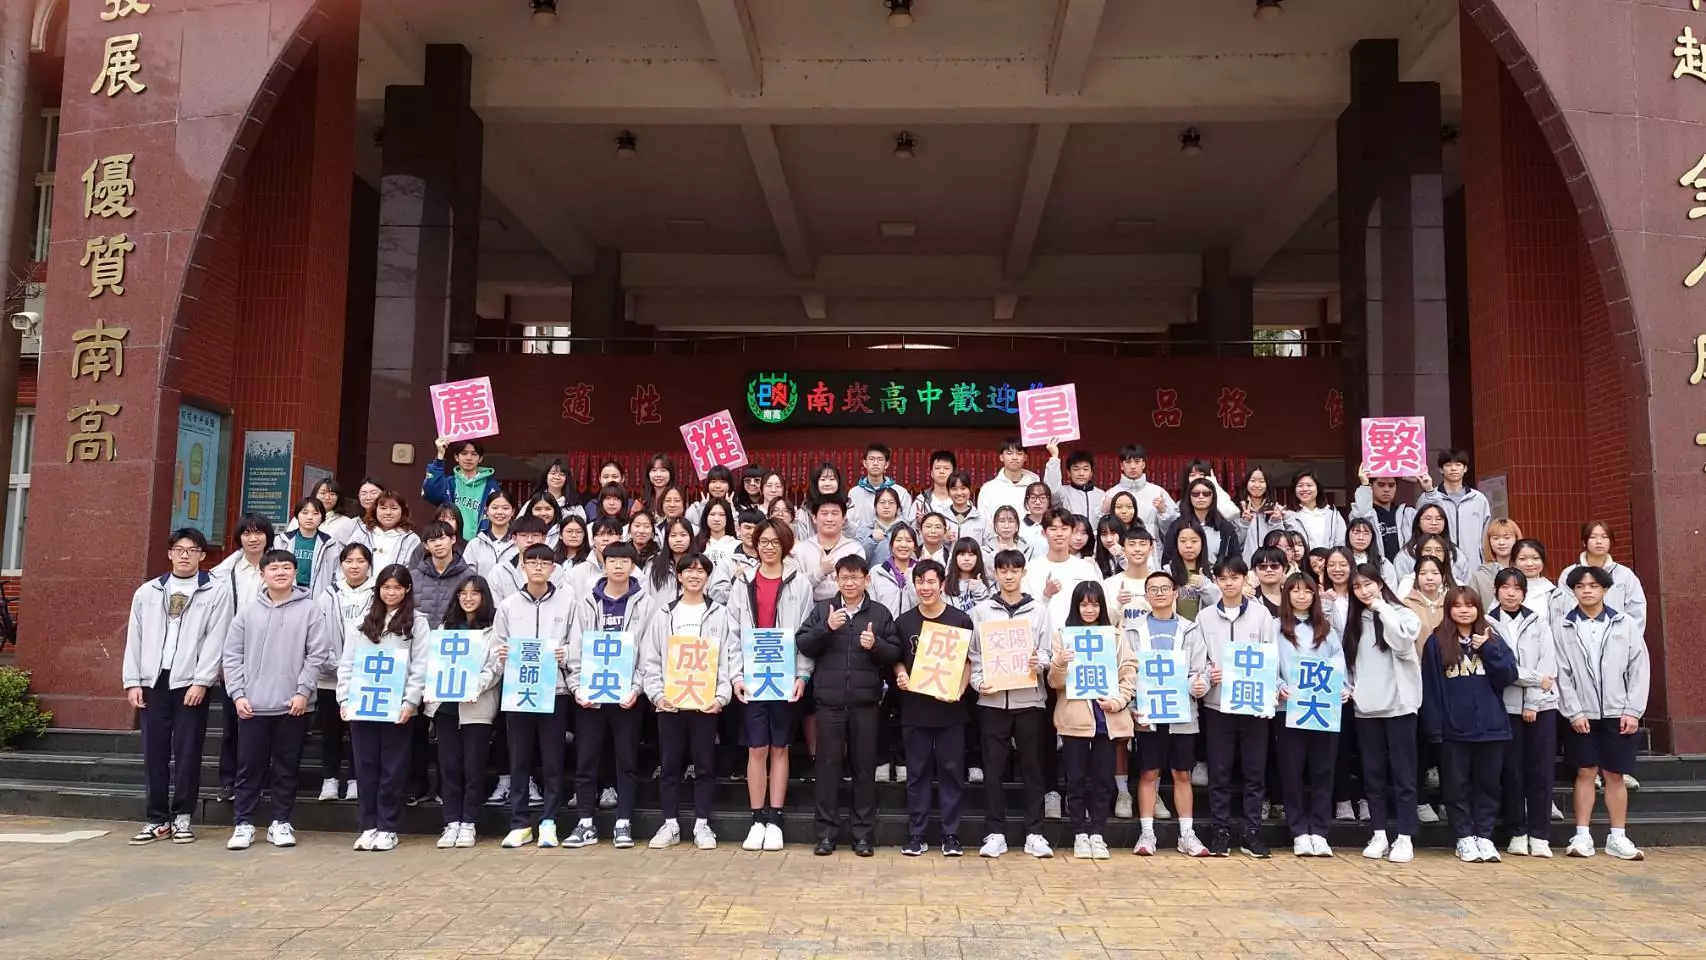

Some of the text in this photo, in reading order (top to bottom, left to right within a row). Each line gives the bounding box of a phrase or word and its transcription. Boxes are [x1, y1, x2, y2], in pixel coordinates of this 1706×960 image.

[438, 384, 489, 436] 薦
[807, 380, 1044, 416] 南崁高中歡迎
[1026, 392, 1073, 439] 星
[689, 419, 741, 472] 推
[1368, 422, 1419, 471] 繁
[356, 651, 395, 717] 中正
[436, 633, 470, 698] 中山
[517, 642, 541, 708] 臺師大
[588, 634, 622, 701] 中央
[672, 640, 710, 706] 成大
[753, 631, 785, 698] 臺大
[916, 629, 960, 696] 成大
[1075, 630, 1109, 696] 中興
[1145, 654, 1181, 720] 中正
[1230, 645, 1264, 713] 中興
[1296, 660, 1334, 729] 政大
